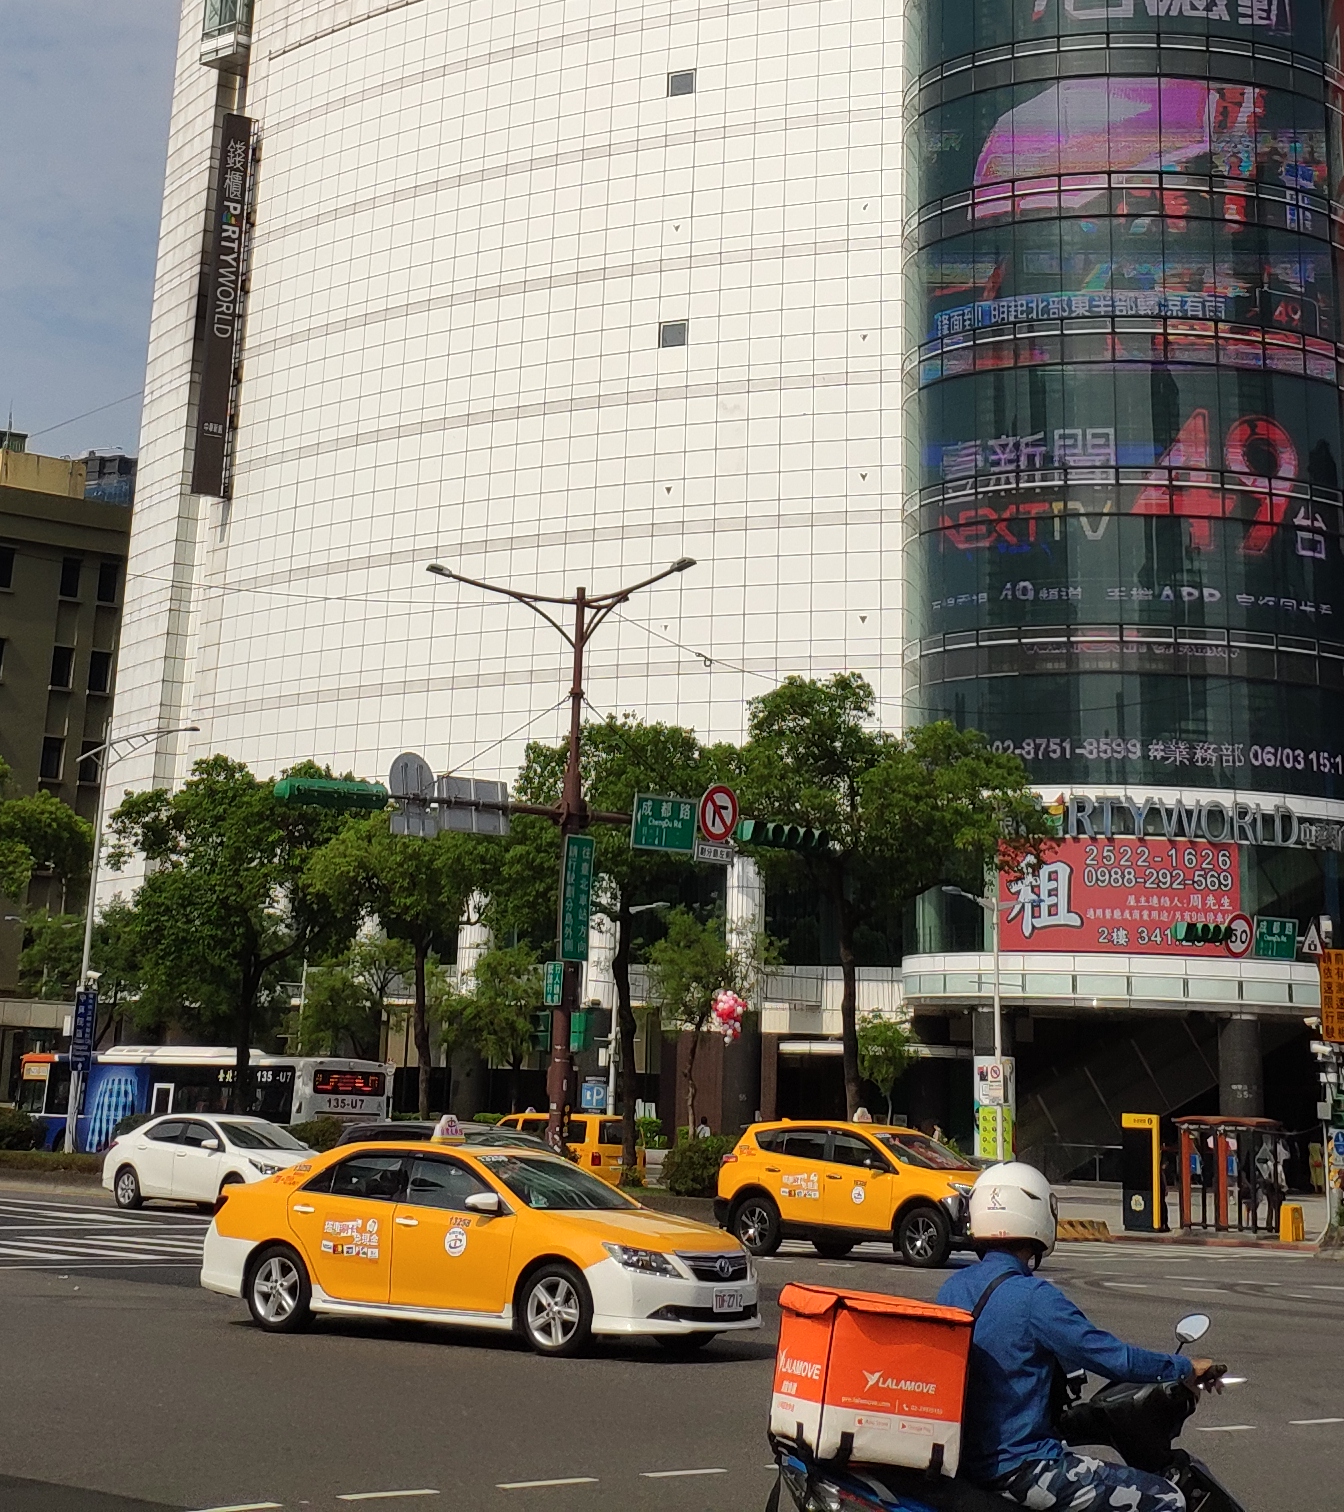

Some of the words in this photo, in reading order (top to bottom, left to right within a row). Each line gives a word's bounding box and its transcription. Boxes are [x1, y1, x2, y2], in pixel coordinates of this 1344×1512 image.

[223, 138, 247, 199] 錢櫃
[1130, 409, 1300, 555] 49
[1250, 745, 1305, 770] 06/03
[641, 799, 692, 820] 成都路
[1084, 845, 1232, 870] 2522-1626
[1083, 867, 1233, 891] 0988-292-569
[1007, 853, 1083, 938] 租
[1097, 926, 1130, 947] 2樓
[1229, 928, 1249, 944] 50
[326, 1097, 365, 1109] 135-U7
[782, 1357, 822, 1380] LALAMOVE
[878, 1377, 937, 1395] LALAMOVE
